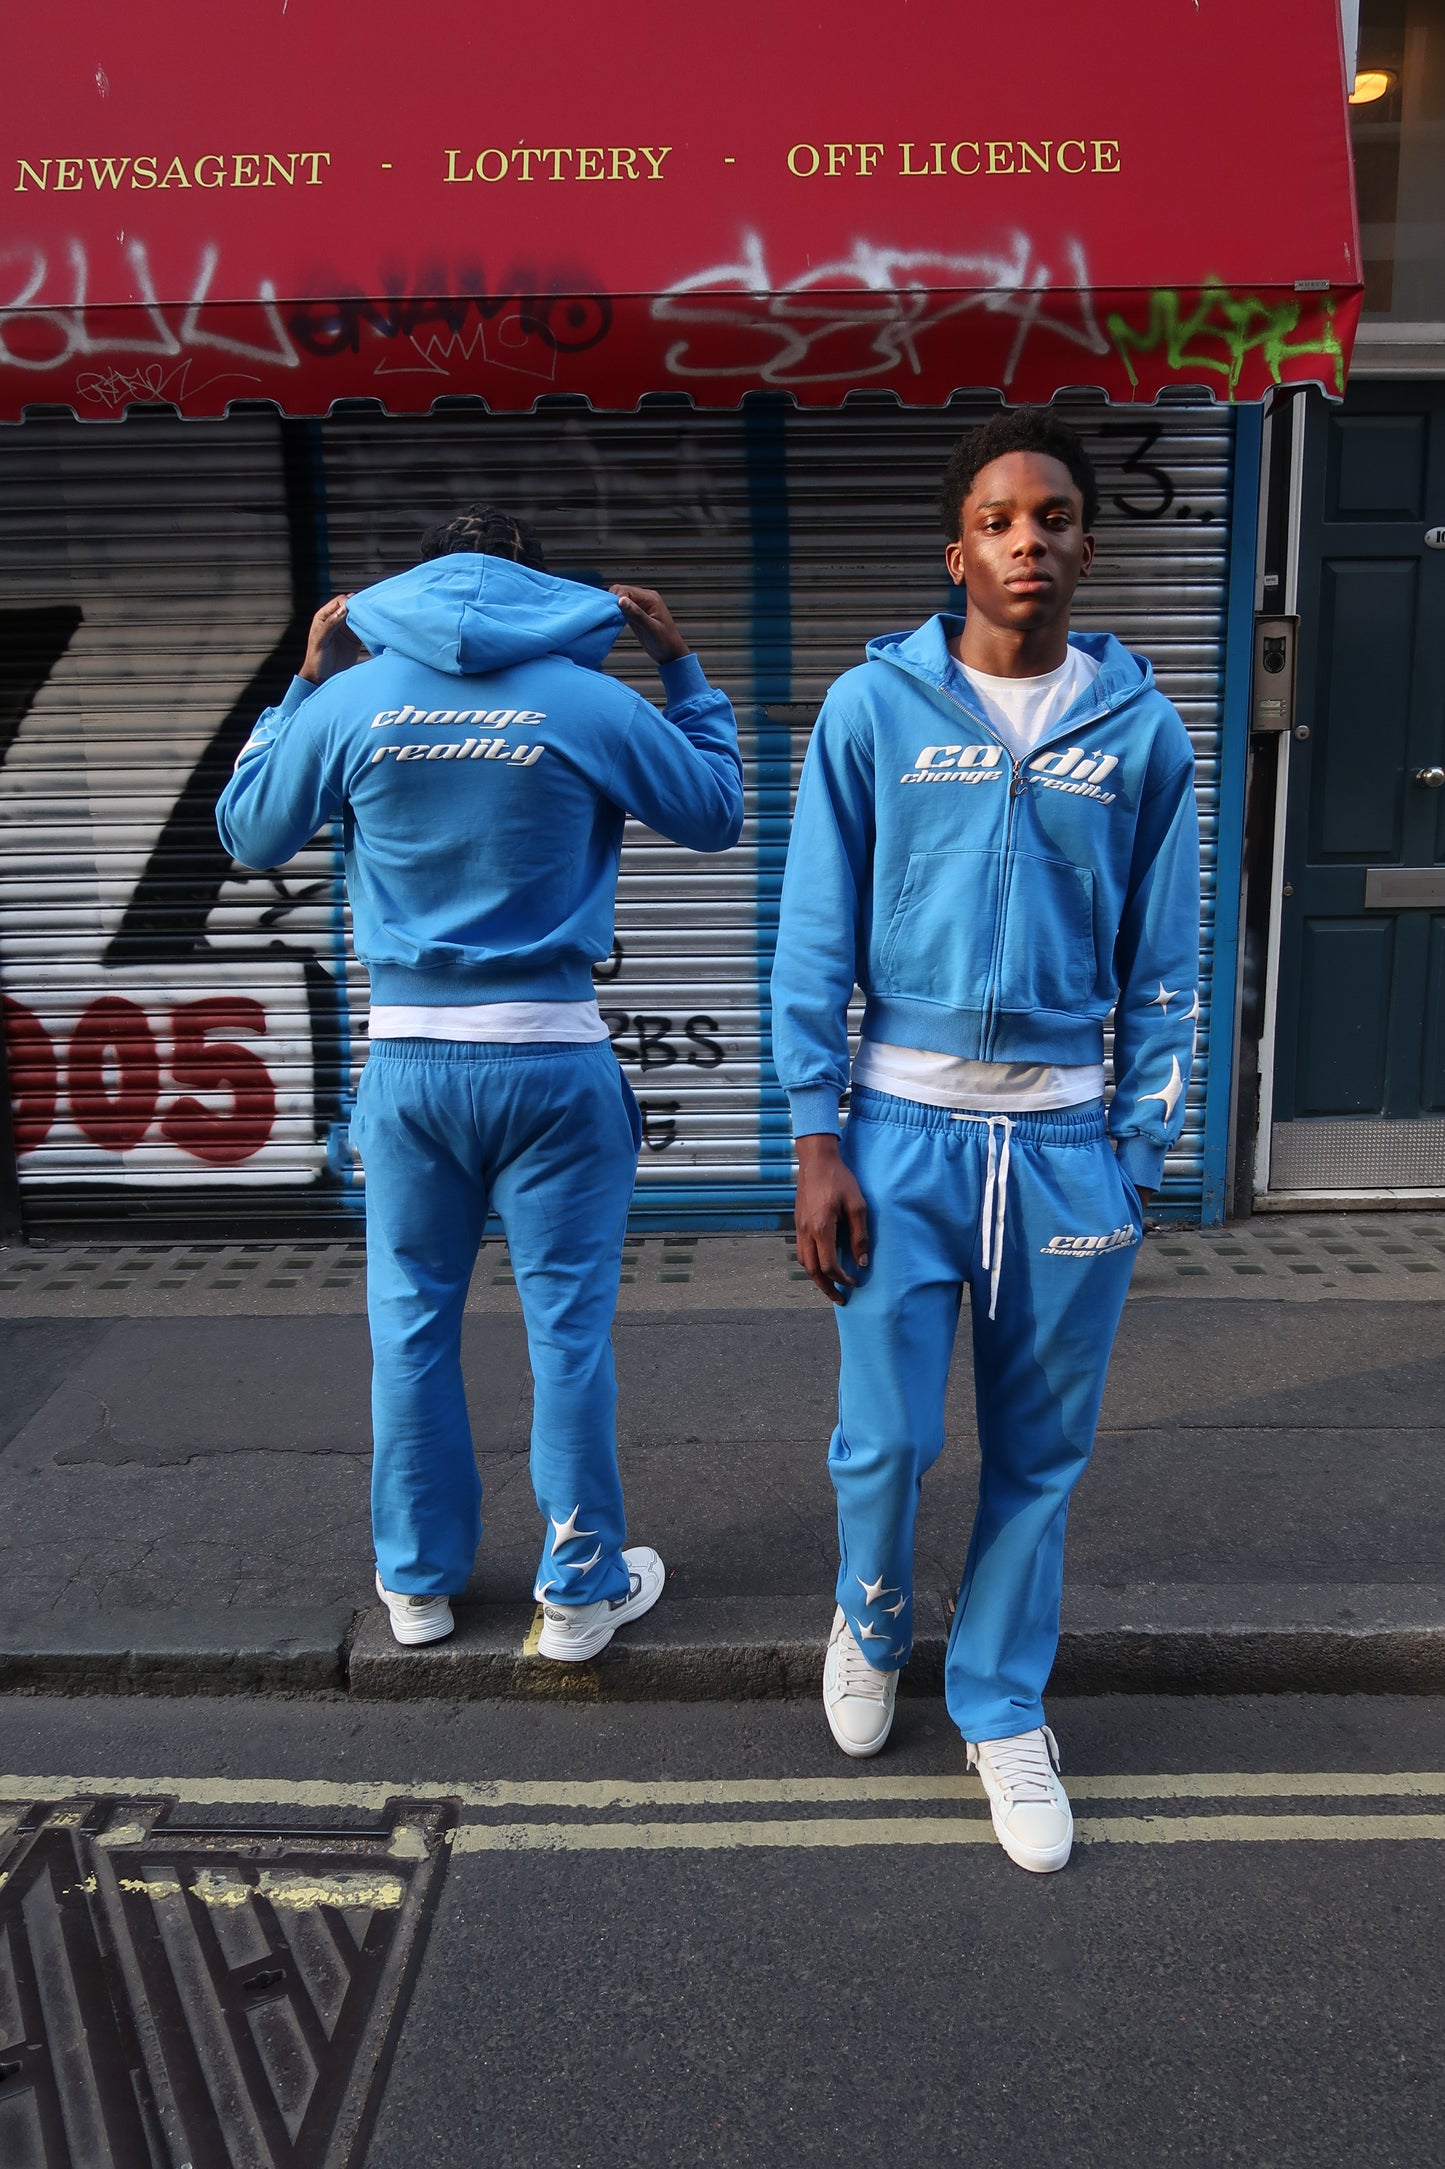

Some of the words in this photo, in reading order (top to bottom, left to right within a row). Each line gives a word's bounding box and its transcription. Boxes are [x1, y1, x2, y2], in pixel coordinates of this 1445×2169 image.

[13, 152, 332, 192] NEWSAGENT
[443, 147, 673, 182] LOTTERY
[787, 143, 884, 178] OFF
[898, 140, 1121, 175] LICENCE
[370, 705, 548, 730] change
[371, 738, 546, 767] reality
[900, 769, 1003, 785] change
[1029, 775, 1117, 805] reality
[1040, 1246, 1097, 1258] change
